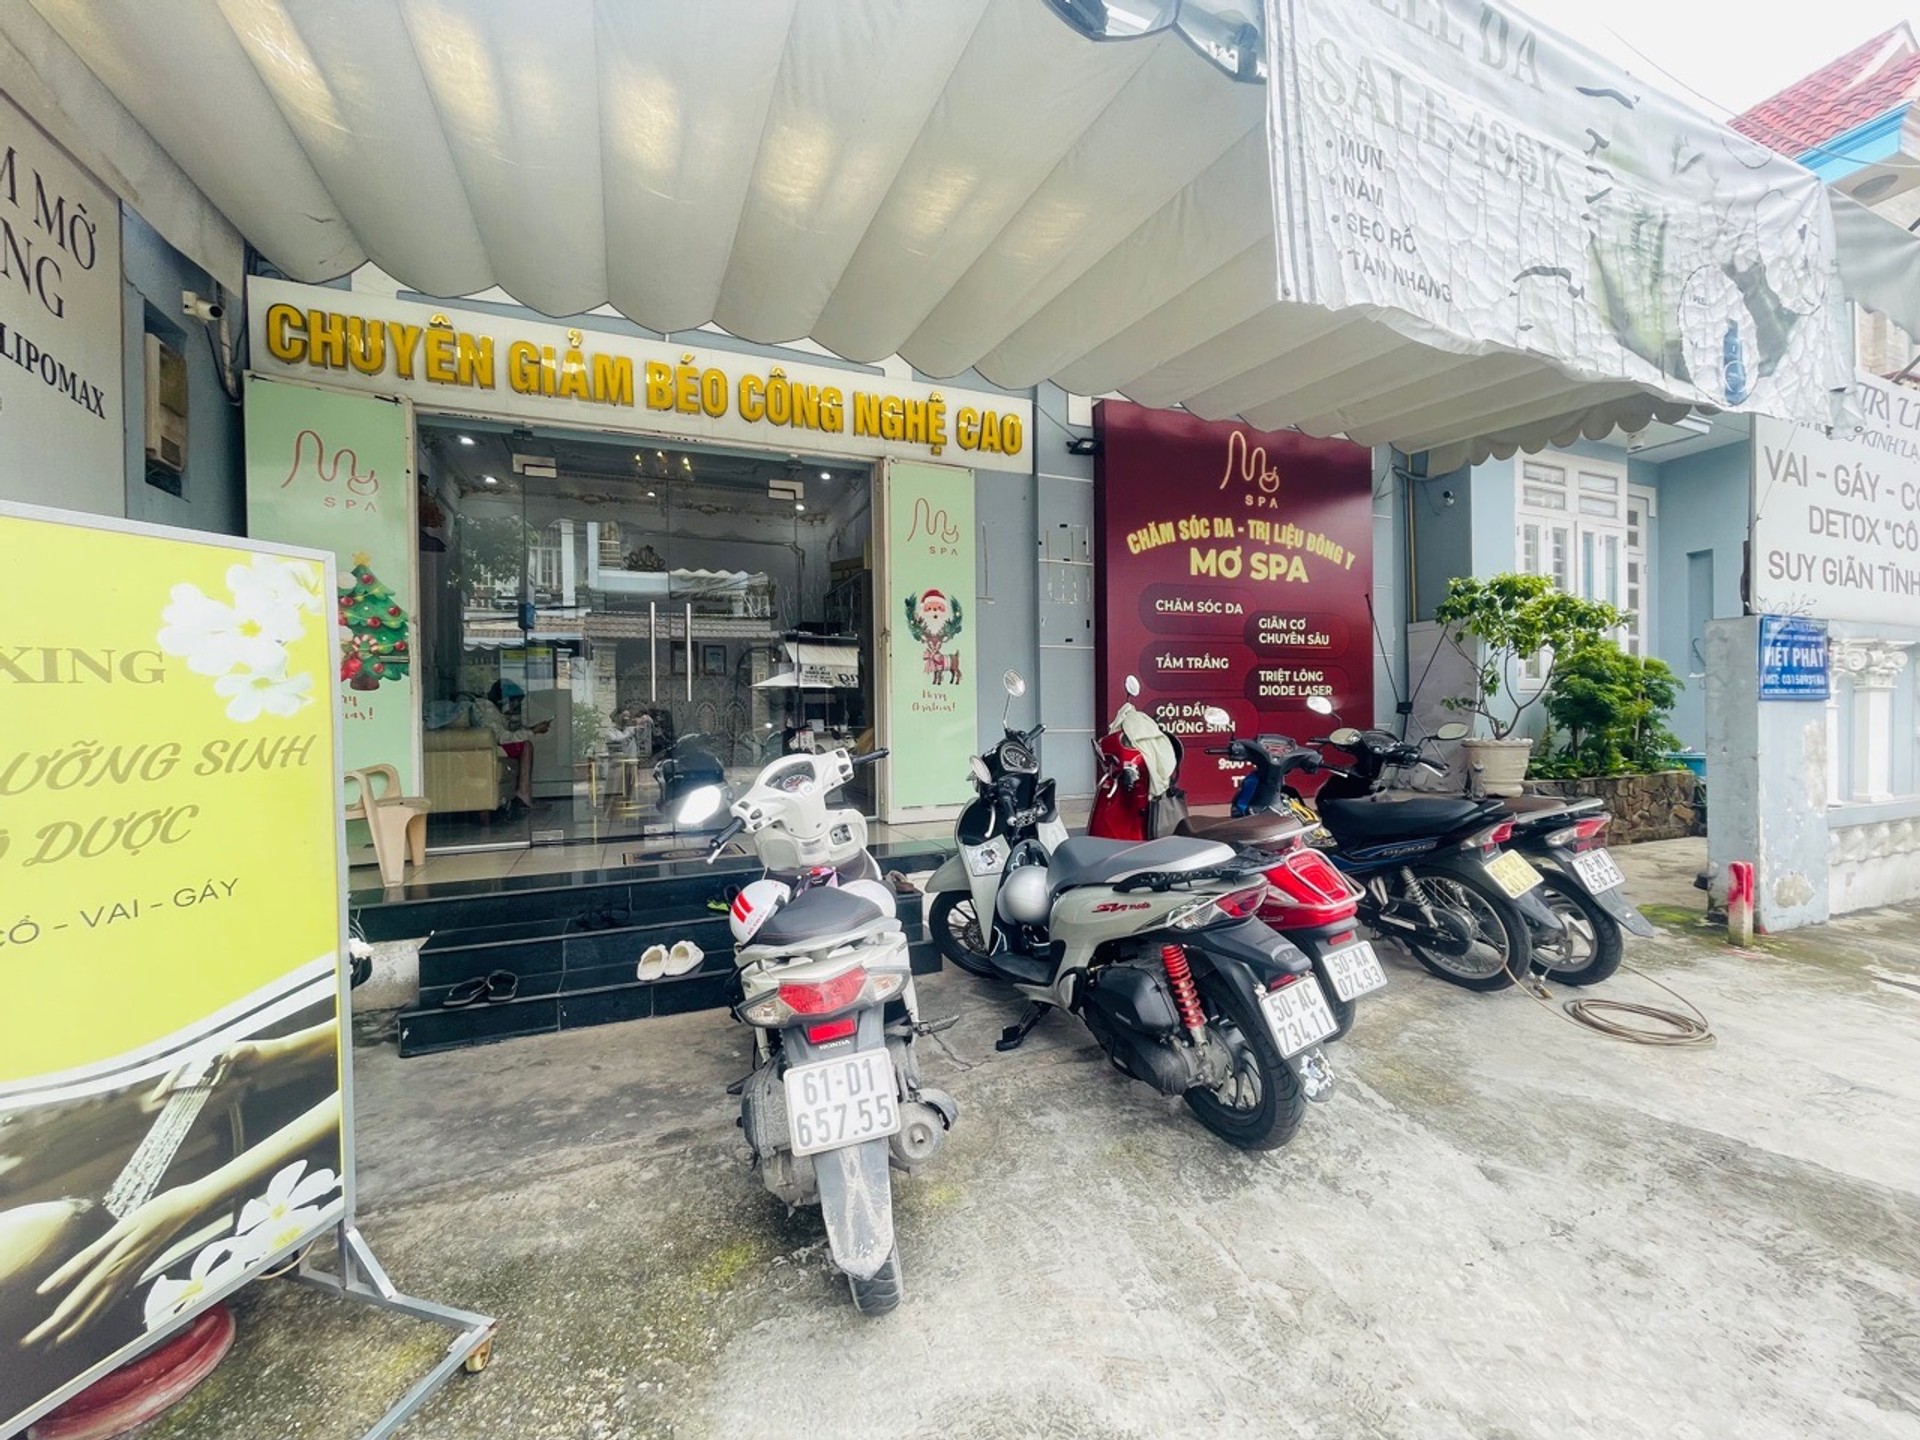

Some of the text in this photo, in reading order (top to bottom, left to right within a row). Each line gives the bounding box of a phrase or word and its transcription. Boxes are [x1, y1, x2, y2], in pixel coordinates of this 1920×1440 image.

[1340, 134, 1383, 171] MỤN
[1393, 263, 1453, 303] NHANG
[0, 322, 106, 420] LIPOMAX
[266, 302, 1023, 457] CHUYÊN GIẢM BÉO CÔNG NGHỆ CAO
[1764, 445, 1808, 487] VAI
[1834, 462, 1880, 503] GÁY
[1901, 482, 1920, 511] C
[324, 496, 377, 512] SPA
[1245, 494, 1278, 509] SPA
[1126, 521, 1176, 555] CHĂM
[1177, 514, 1211, 541] SÓC
[1213, 517, 1235, 538] DA
[1247, 519, 1270, 546] TRỊ
[1274, 522, 1304, 550] LIỆU
[1306, 532, 1344, 565] ĐÔNG
[1345, 551, 1356, 571] Y
[1809, 505, 1881, 546] DETOX
[929, 546, 958, 556] SPA
[1190, 546, 1309, 583] MƠ SPA
[1768, 550, 1816, 583] SUY
[1822, 555, 1873, 590] GIÃN
[1155, 598, 1243, 615] CHĂM SÓC DA
[1258, 617, 1306, 630] GIÃN CƠ
[1258, 631, 1329, 646] CHUYÊN SÂU
[1792, 643, 1824, 668] PHÁT
[1258, 667, 1324, 684] TRIỆT LÔNG
[1259, 685, 1333, 696] DIODE LASER
[1156, 702, 1179, 719] GỘI
[193, 733, 318, 778] SINH
[22, 804, 200, 867] DƯỢC
[80, 899, 138, 928] VAI
[173, 877, 239, 908] GÁY
[1278, 1006, 1333, 1053] 734.11
[802, 1058, 875, 1105] 61-D1
[796, 1093, 893, 1148] 657.55
